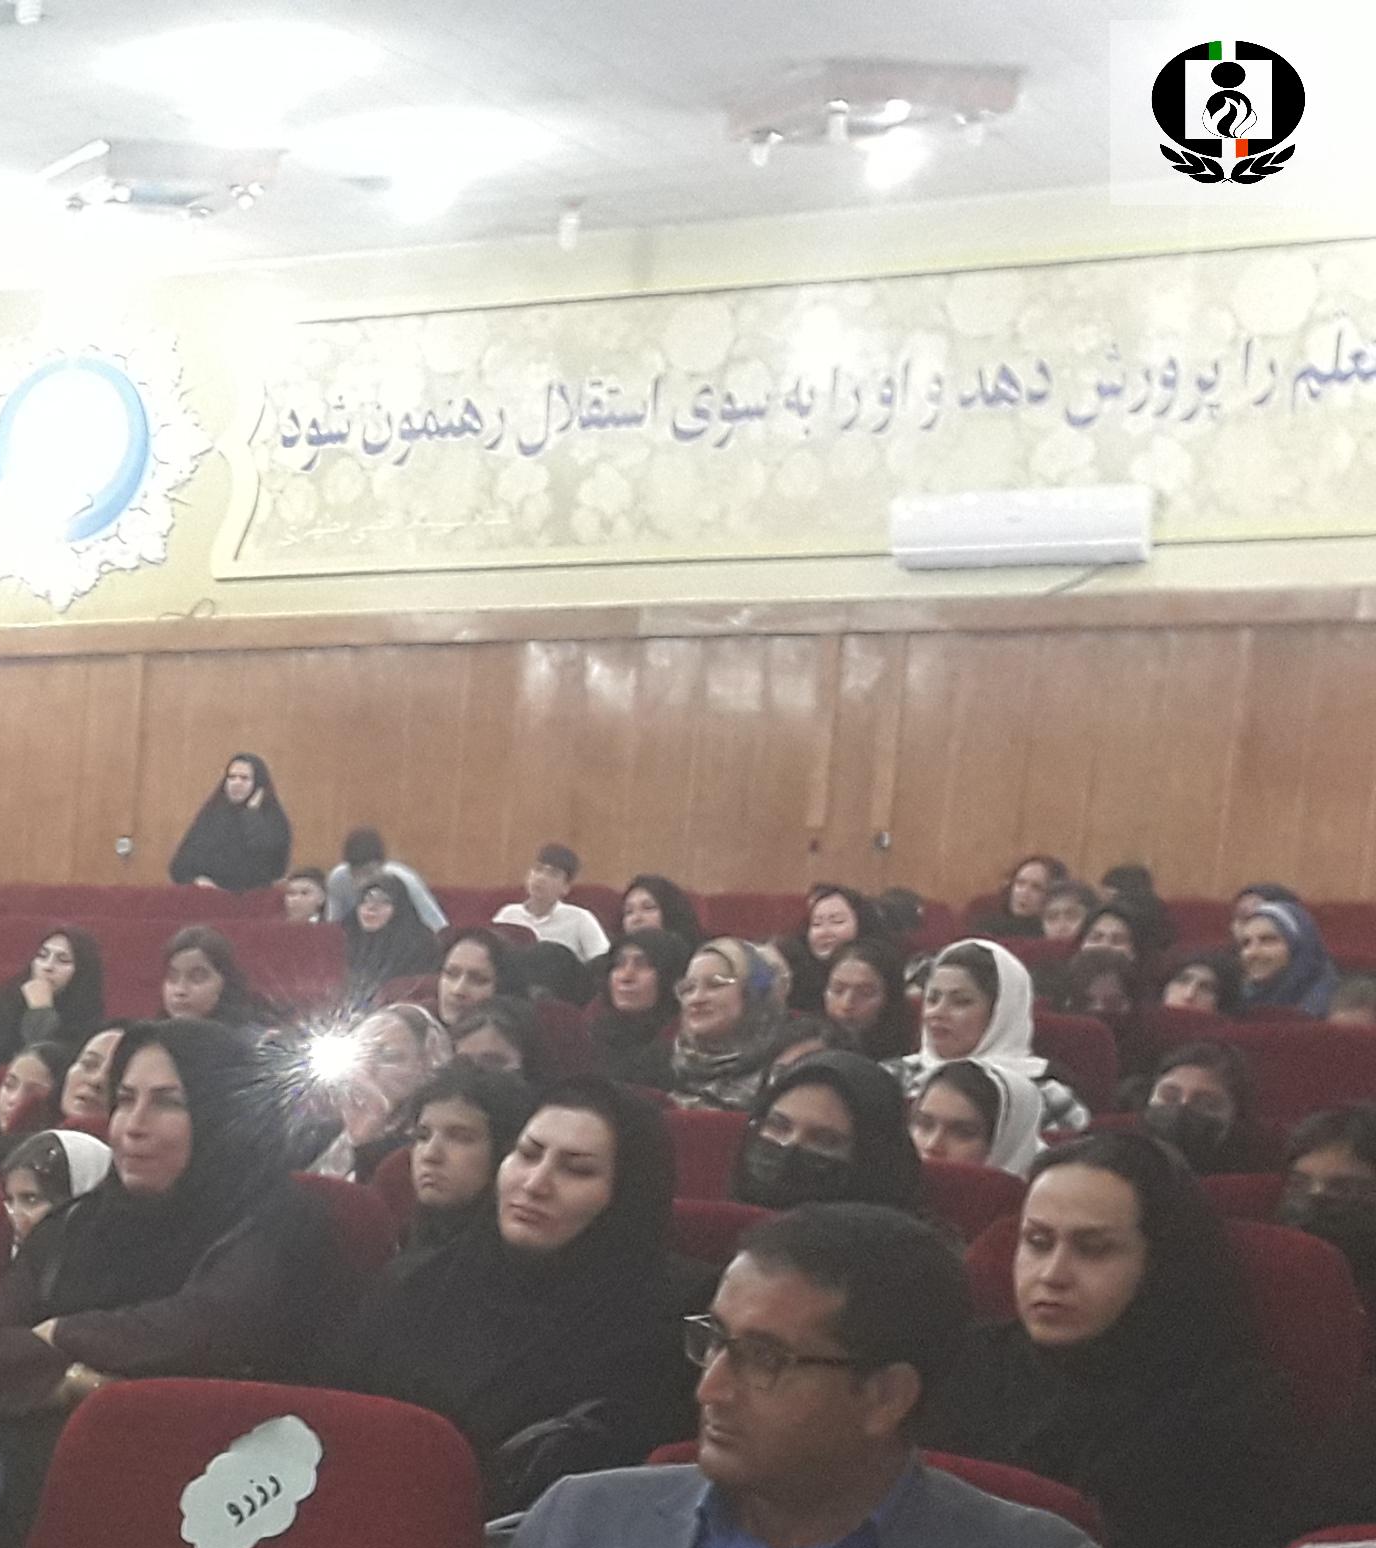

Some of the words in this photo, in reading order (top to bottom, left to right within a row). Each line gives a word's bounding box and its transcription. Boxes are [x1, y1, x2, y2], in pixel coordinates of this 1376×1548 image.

[831, 364, 861, 432] را
[870, 360, 910, 434] او
[919, 375, 944, 431] و
[958, 357, 1053, 409] دهد
[1064, 342, 1222, 428] پرورش
[1245, 337, 1278, 406] را
[278, 392, 352, 474] شود
[360, 396, 506, 468] رهنمون
[516, 372, 664, 458] استقلال
[671, 384, 769, 449] سوی
[783, 378, 816, 436] به
[226, 1474, 282, 1528] رزرو
